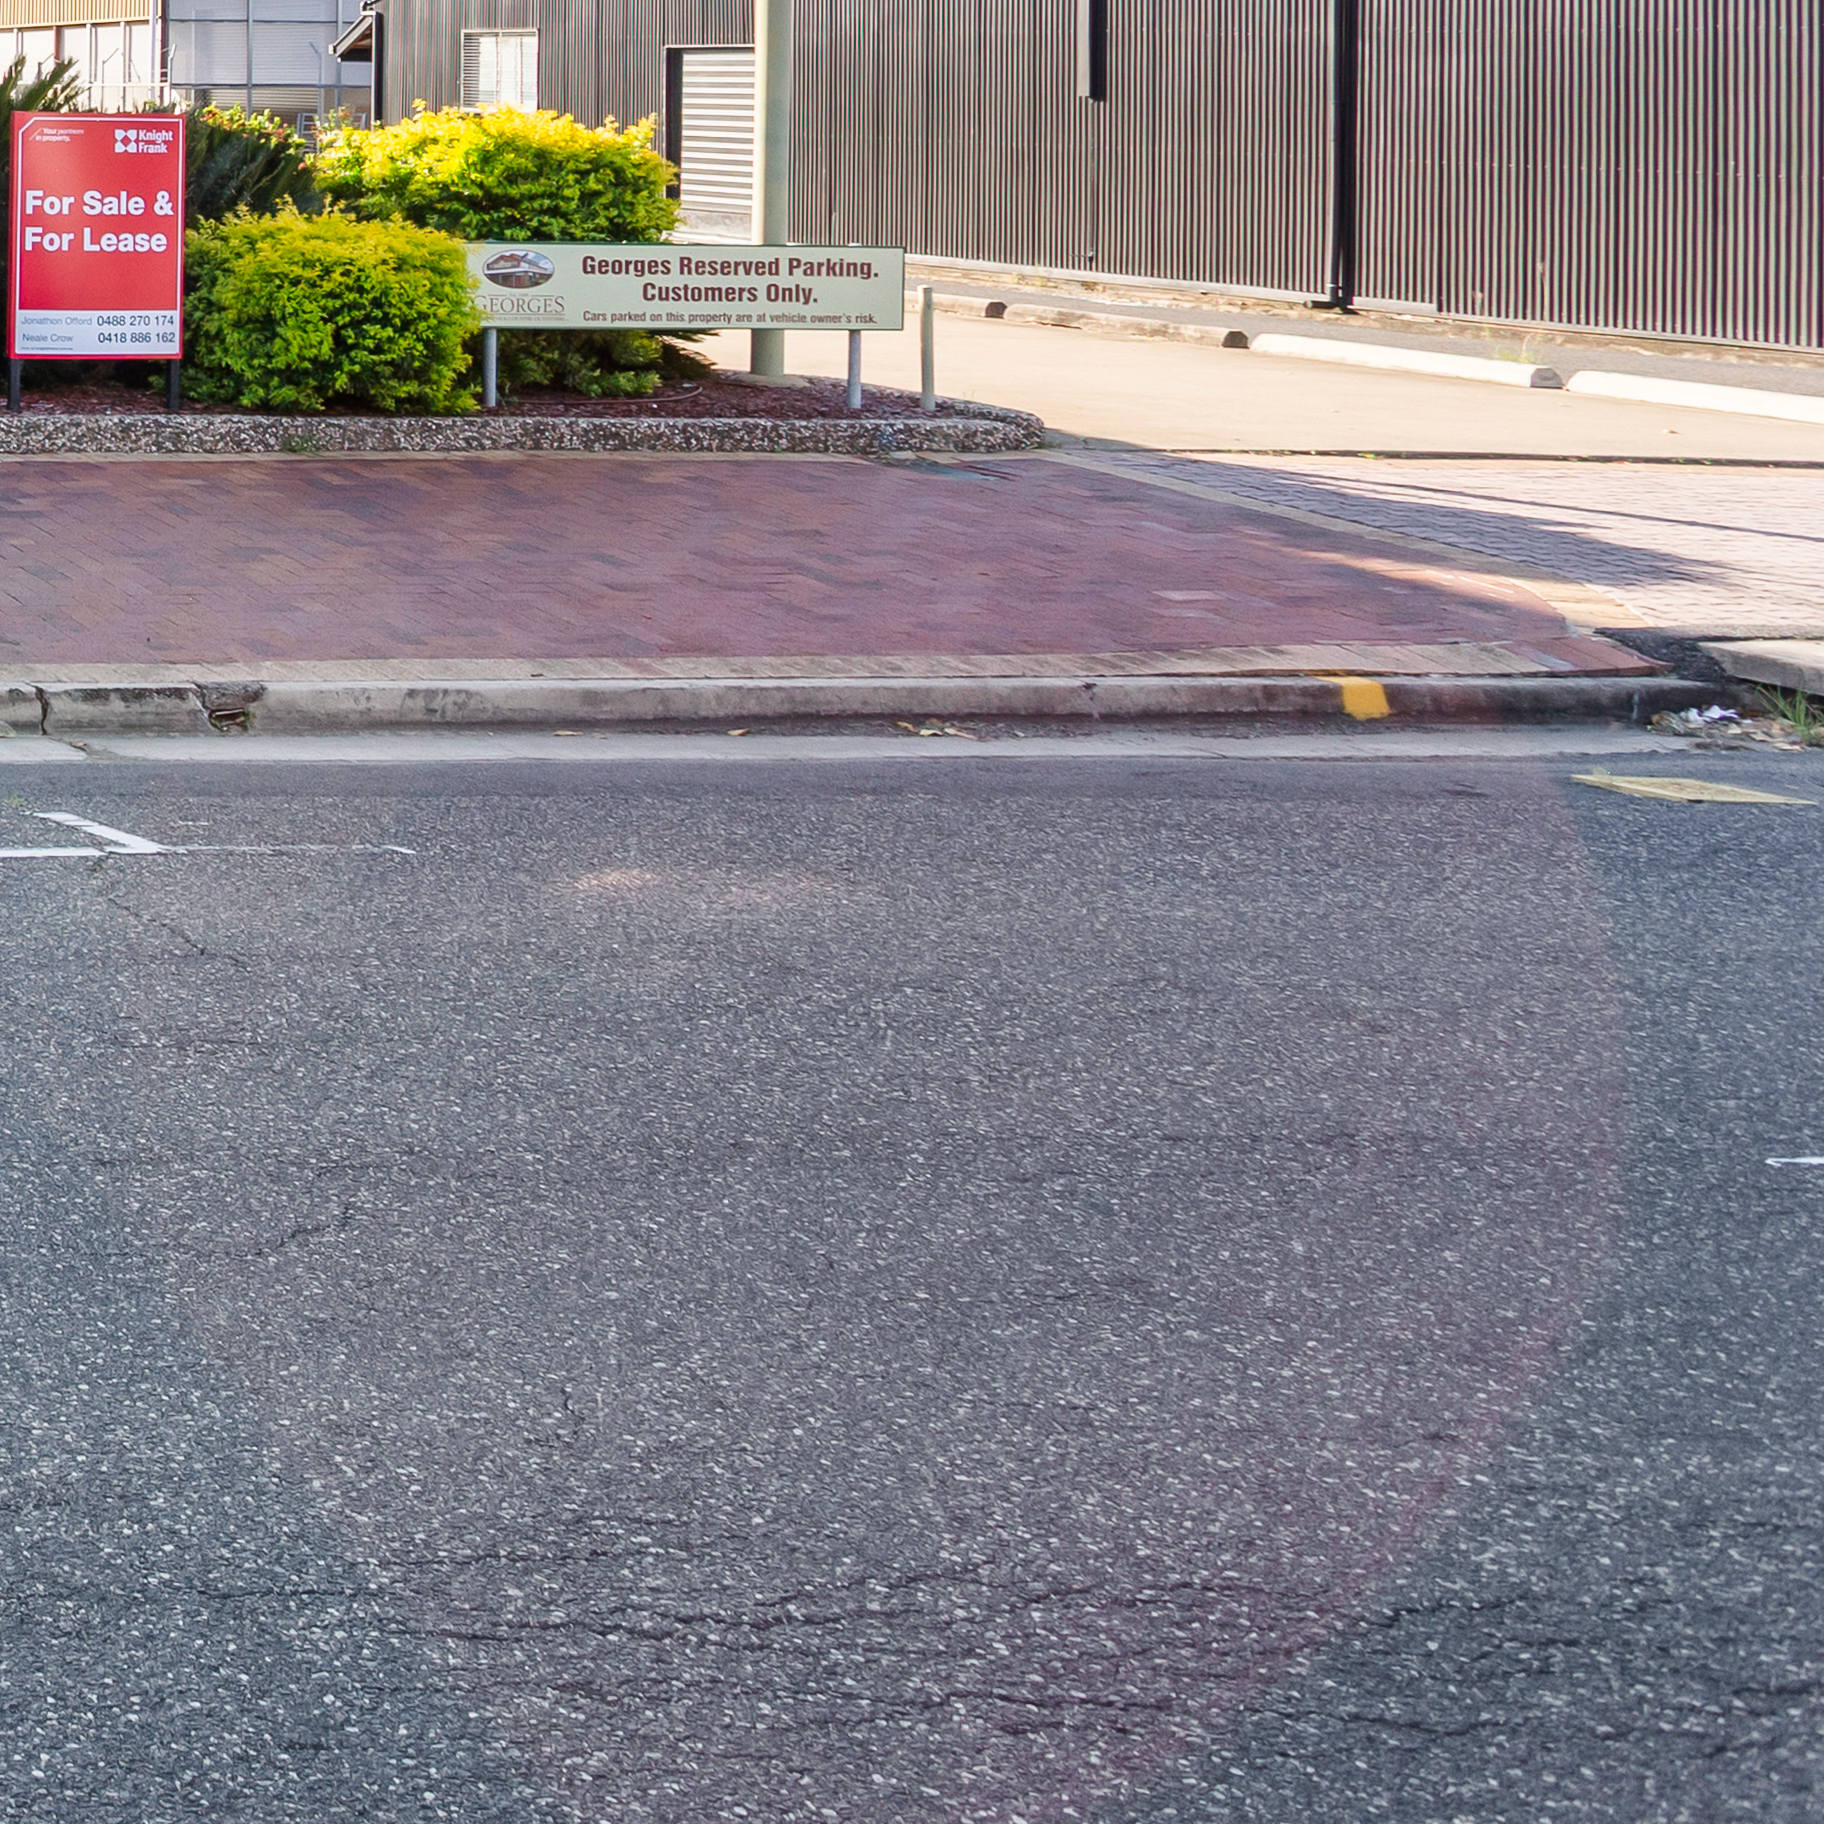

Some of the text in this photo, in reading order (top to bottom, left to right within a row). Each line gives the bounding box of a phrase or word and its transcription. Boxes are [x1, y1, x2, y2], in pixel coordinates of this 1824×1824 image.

[138, 129, 174, 142] Knight
[138, 143, 168, 153] Frank
[25, 190, 175, 216] For Sale &
[24, 227, 168, 253] For Lease
[582, 256, 879, 280] Georges Reserved Parking.
[642, 282, 818, 305] Customers Only.
[472, 295, 565, 314] GEORGES
[97, 315, 126, 327] 0488
[129, 315, 151, 326] 270
[155, 315, 174, 326] 174
[583, 310, 878, 325] Cars parked on this property are at vehicle owner's risk.
[98, 332, 127, 344] 0418
[156, 332, 176, 343] 162
